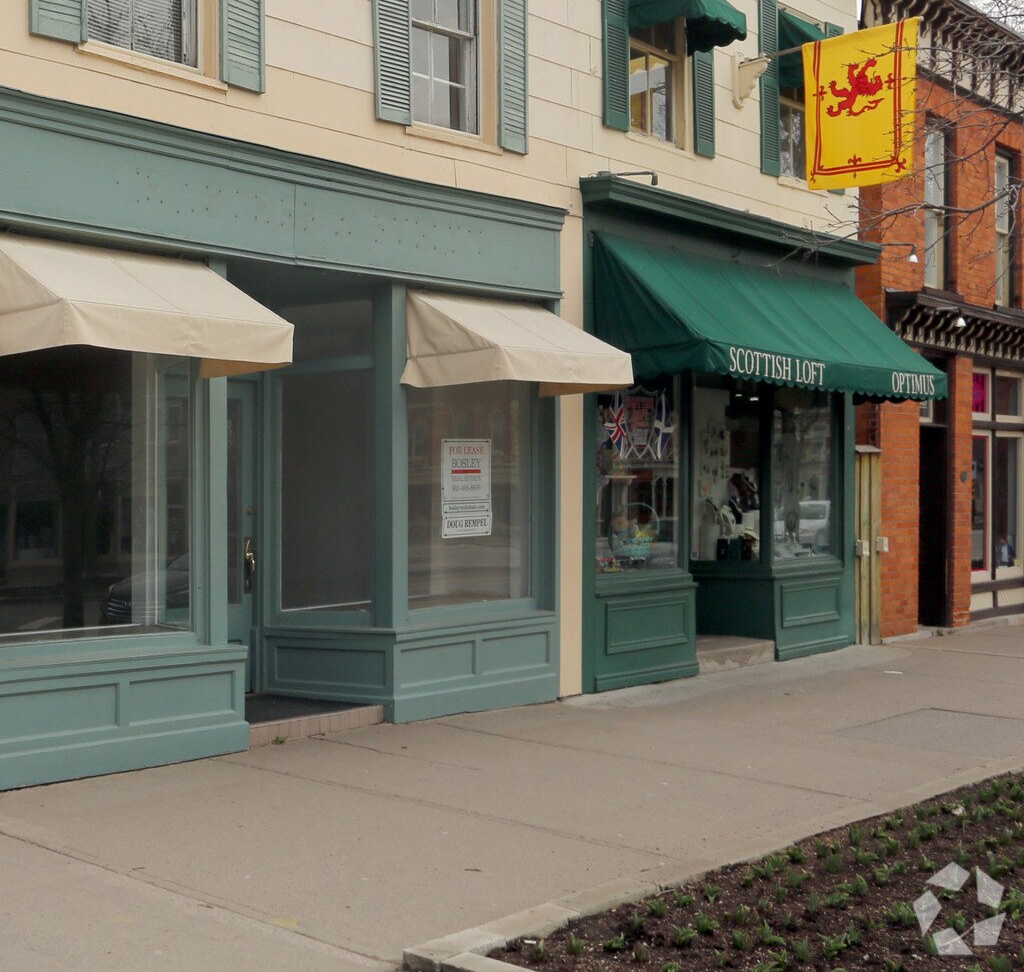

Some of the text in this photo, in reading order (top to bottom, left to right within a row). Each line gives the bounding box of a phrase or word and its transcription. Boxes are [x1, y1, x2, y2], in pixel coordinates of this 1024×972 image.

[729, 346, 826, 386] SCOTTISH LOFT
[891, 371, 935, 396] OPTIMUS
[448, 445, 485, 455] FOR LEASE
[451, 458, 481, 469] BOSLEY
[447, 518, 488, 529] DOUG REMPEL
